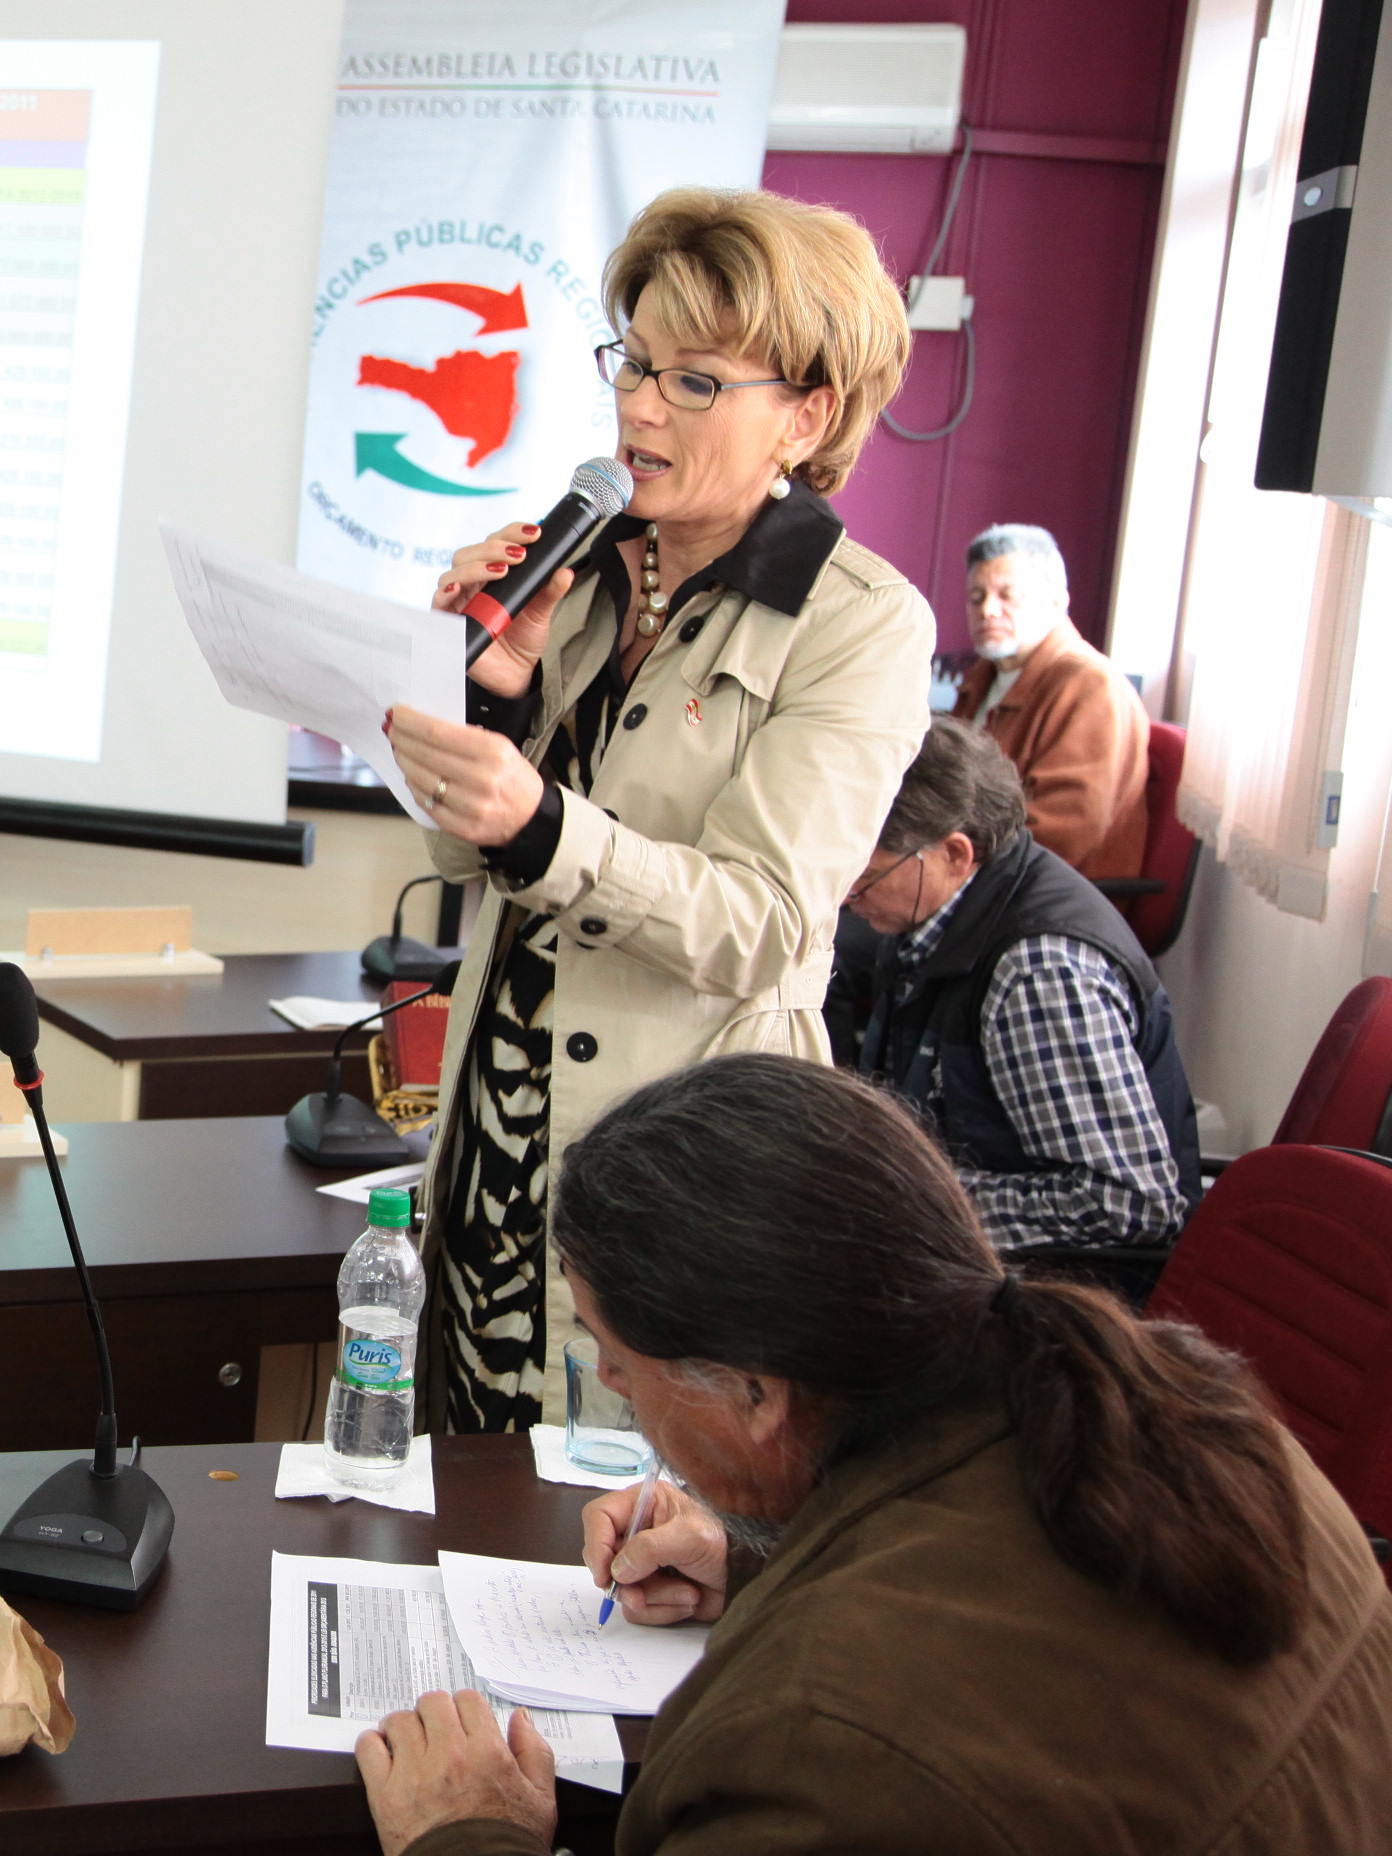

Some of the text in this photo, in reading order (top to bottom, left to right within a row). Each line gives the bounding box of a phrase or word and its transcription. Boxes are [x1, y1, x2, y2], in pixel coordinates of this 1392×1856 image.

[341, 50, 721, 85] ASSEMBLEIA LEGISLATIVA
[336, 96, 372, 118] DO
[378, 96, 466, 119] ESTADO
[474, 97, 504, 119] DE
[593, 97, 717, 125] CATARINA
[394, 219, 545, 266] PÚBLICAS
[348, 1343, 393, 1365] Puris
[40, 1525, 63, 1534] YOGA
